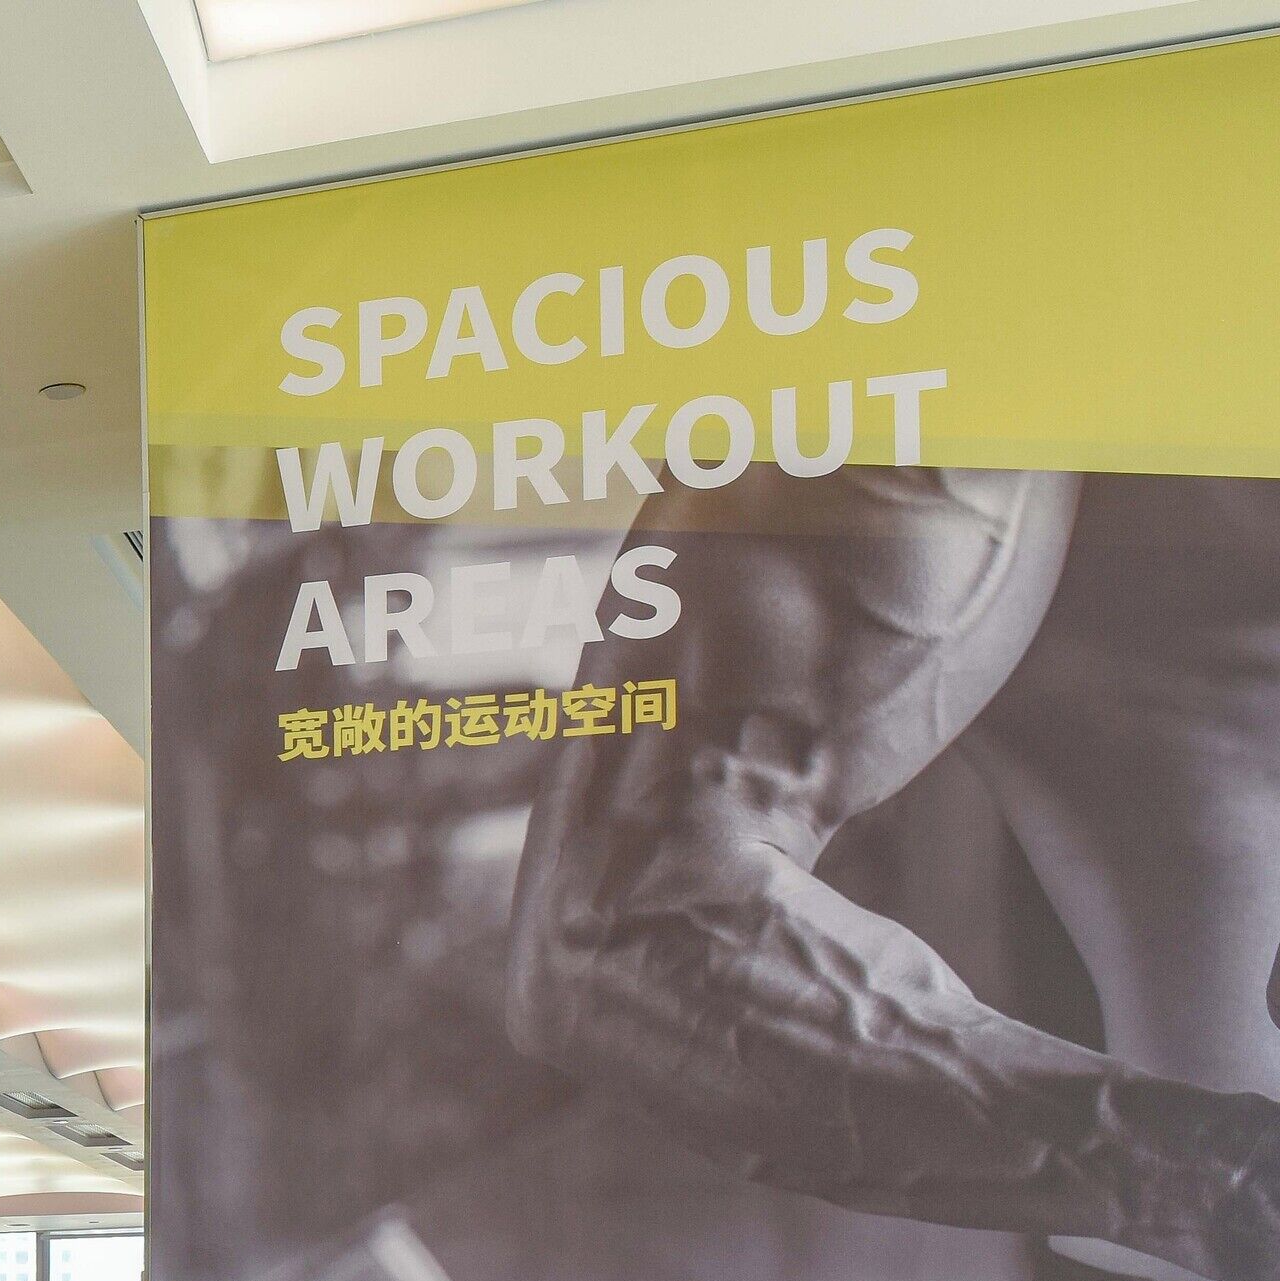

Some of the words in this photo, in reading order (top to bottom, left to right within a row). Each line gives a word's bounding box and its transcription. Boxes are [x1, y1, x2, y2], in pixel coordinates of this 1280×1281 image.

[278, 228, 920, 397] SPACIOUS
[276, 370, 948, 534] WORKOUT
[275, 546, 683, 672] AREAS
[277, 680, 679, 763] 宽敞的运动空间
